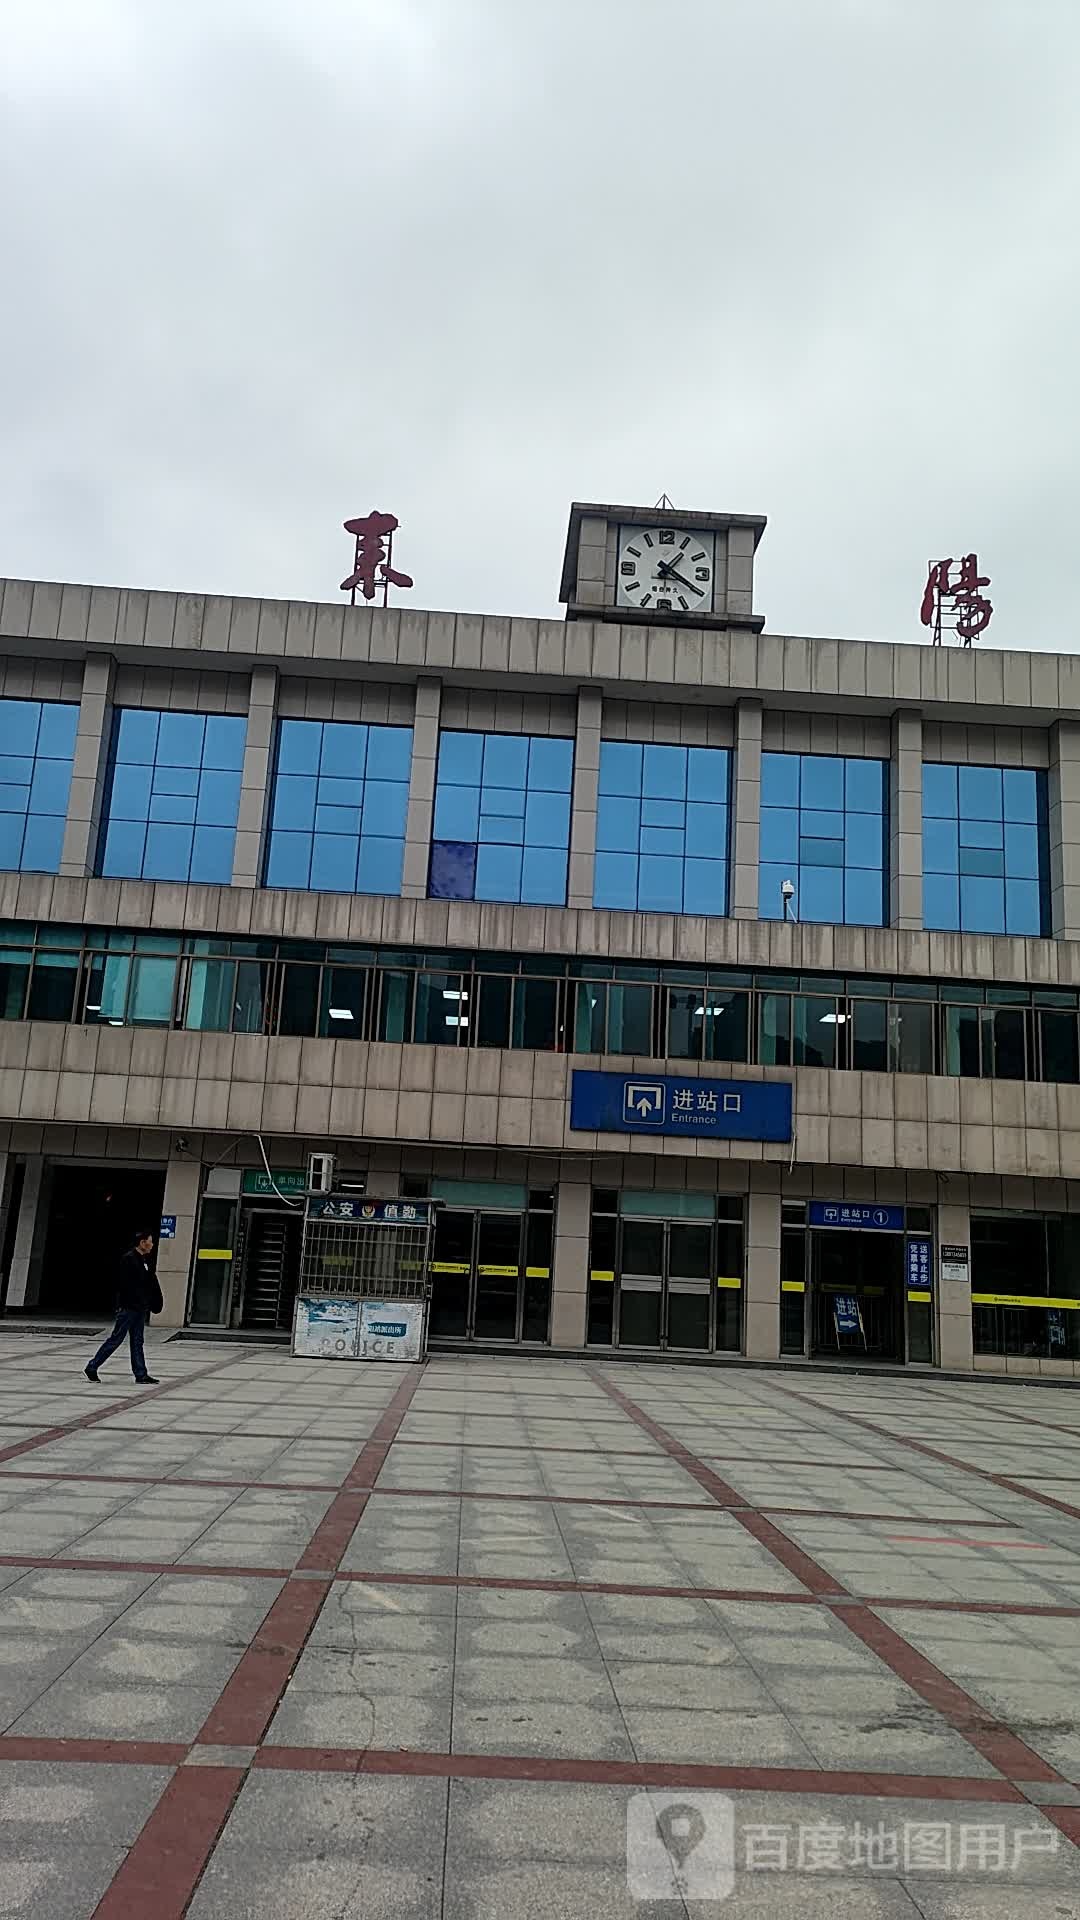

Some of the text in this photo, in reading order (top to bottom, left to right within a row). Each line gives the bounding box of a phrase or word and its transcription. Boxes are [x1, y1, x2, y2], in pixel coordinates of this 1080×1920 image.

[659, 530, 675, 545] 12
[621, 561, 636, 576] 9
[695, 566, 710, 582] 3
[672, 1089, 741, 1113] 进站口
[671, 1113, 717, 1125] Entrance
[322, 1201, 354, 1217] 公安
[841, 1208, 870, 1218] 进站口
[919, 1244, 929, 1283] 送客止步
[835, 1297, 857, 1316] 进站
